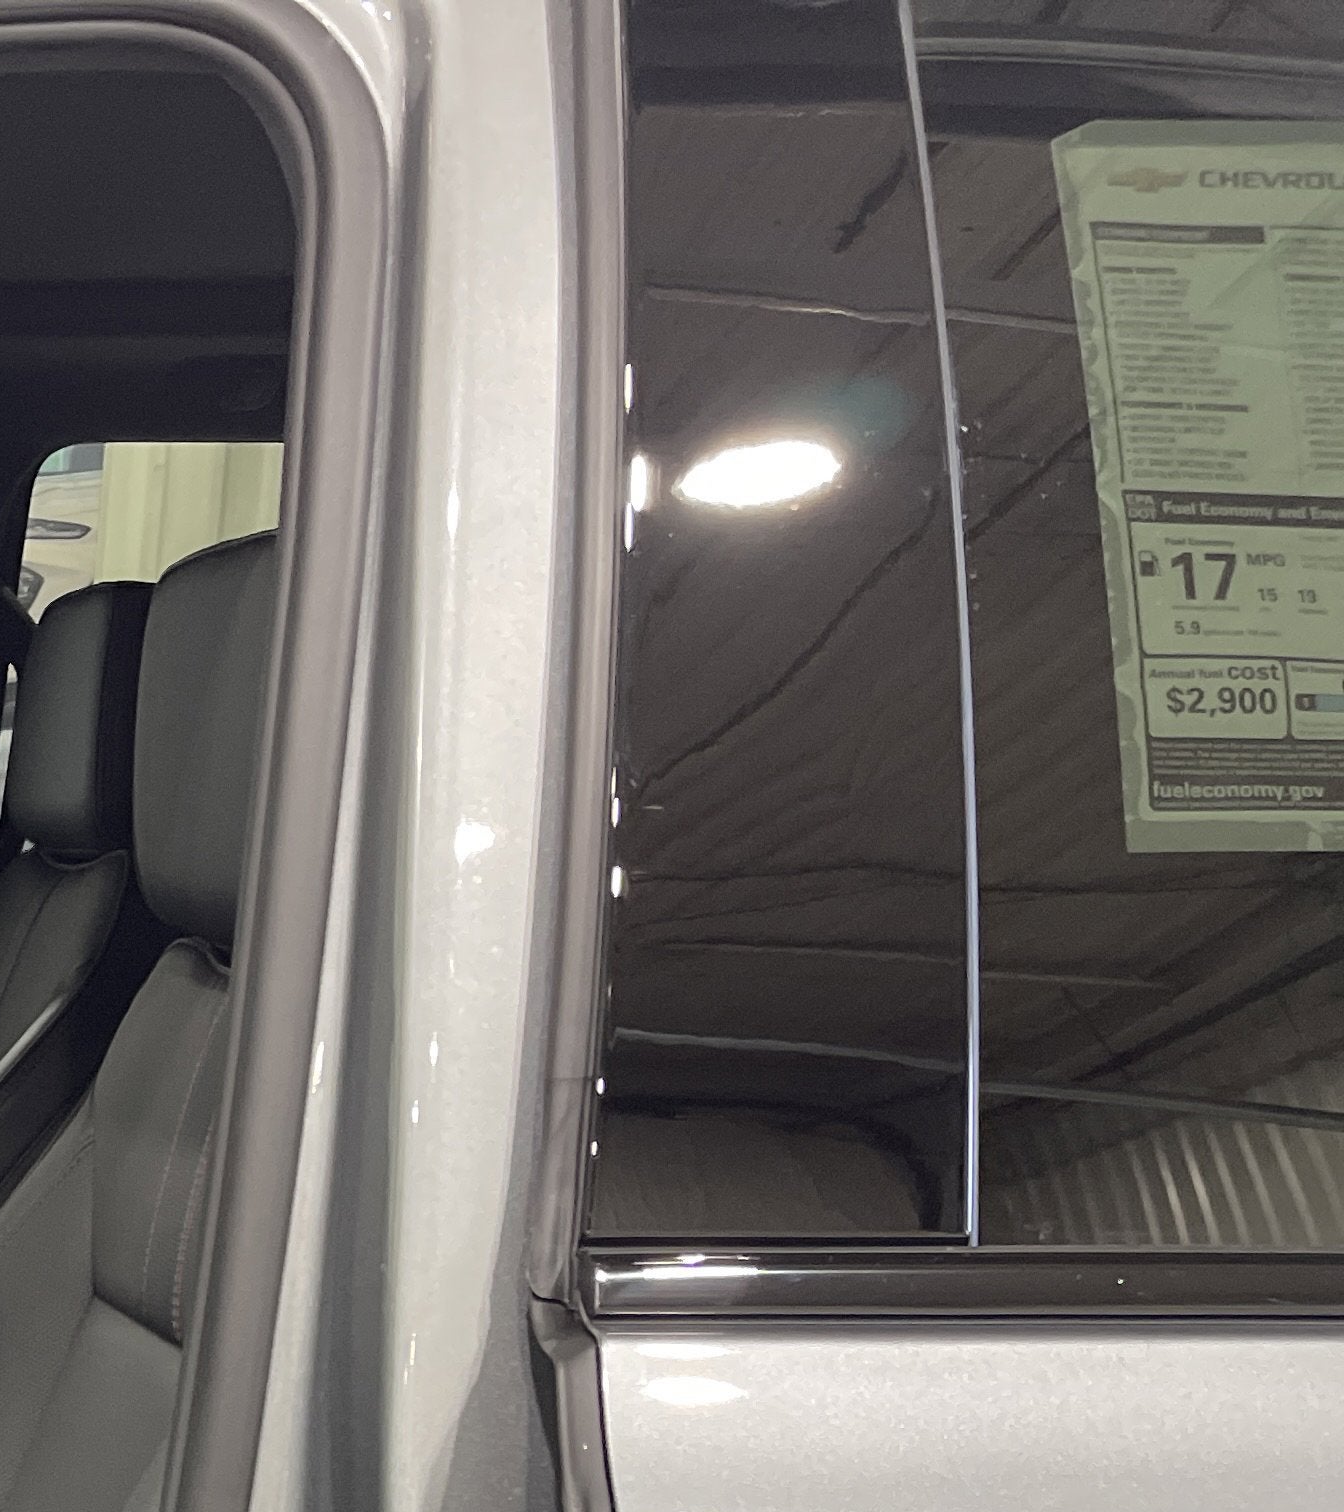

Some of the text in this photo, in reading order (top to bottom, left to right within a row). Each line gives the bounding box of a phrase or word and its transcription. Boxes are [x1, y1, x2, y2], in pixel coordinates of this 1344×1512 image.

[1162, 501, 1196, 515] Fuel
[1201, 503, 1274, 521] Economy
[1277, 506, 1306, 518] and
[1171, 552, 1286, 600] 17 MPG
[1258, 588, 1278, 602] 15
[1166, 685, 1278, 717] $2,900
[1151, 781, 1326, 802] fueleconomy.gov
